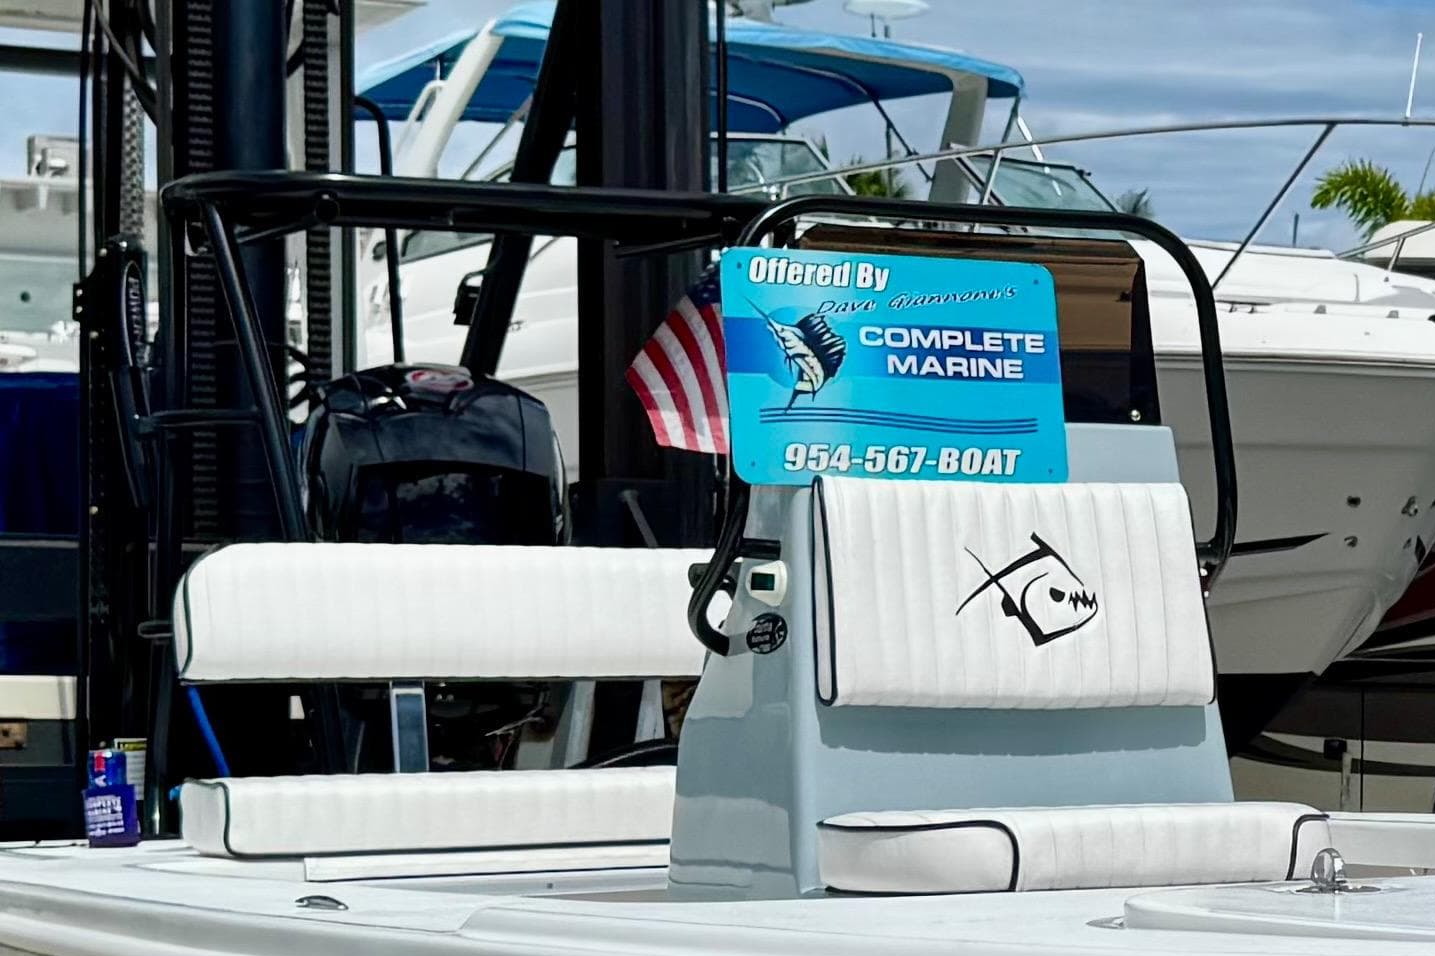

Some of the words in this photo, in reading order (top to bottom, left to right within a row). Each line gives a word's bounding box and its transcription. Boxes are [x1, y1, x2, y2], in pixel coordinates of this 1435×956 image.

[749, 256, 853, 288] Offered
[856, 262, 890, 292] By
[816, 299, 877, 315] Dave
[859, 326, 1045, 353] COMPLETE
[887, 355, 1024, 378] MARINE
[784, 443, 1021, 475] 954-567-BOAT
